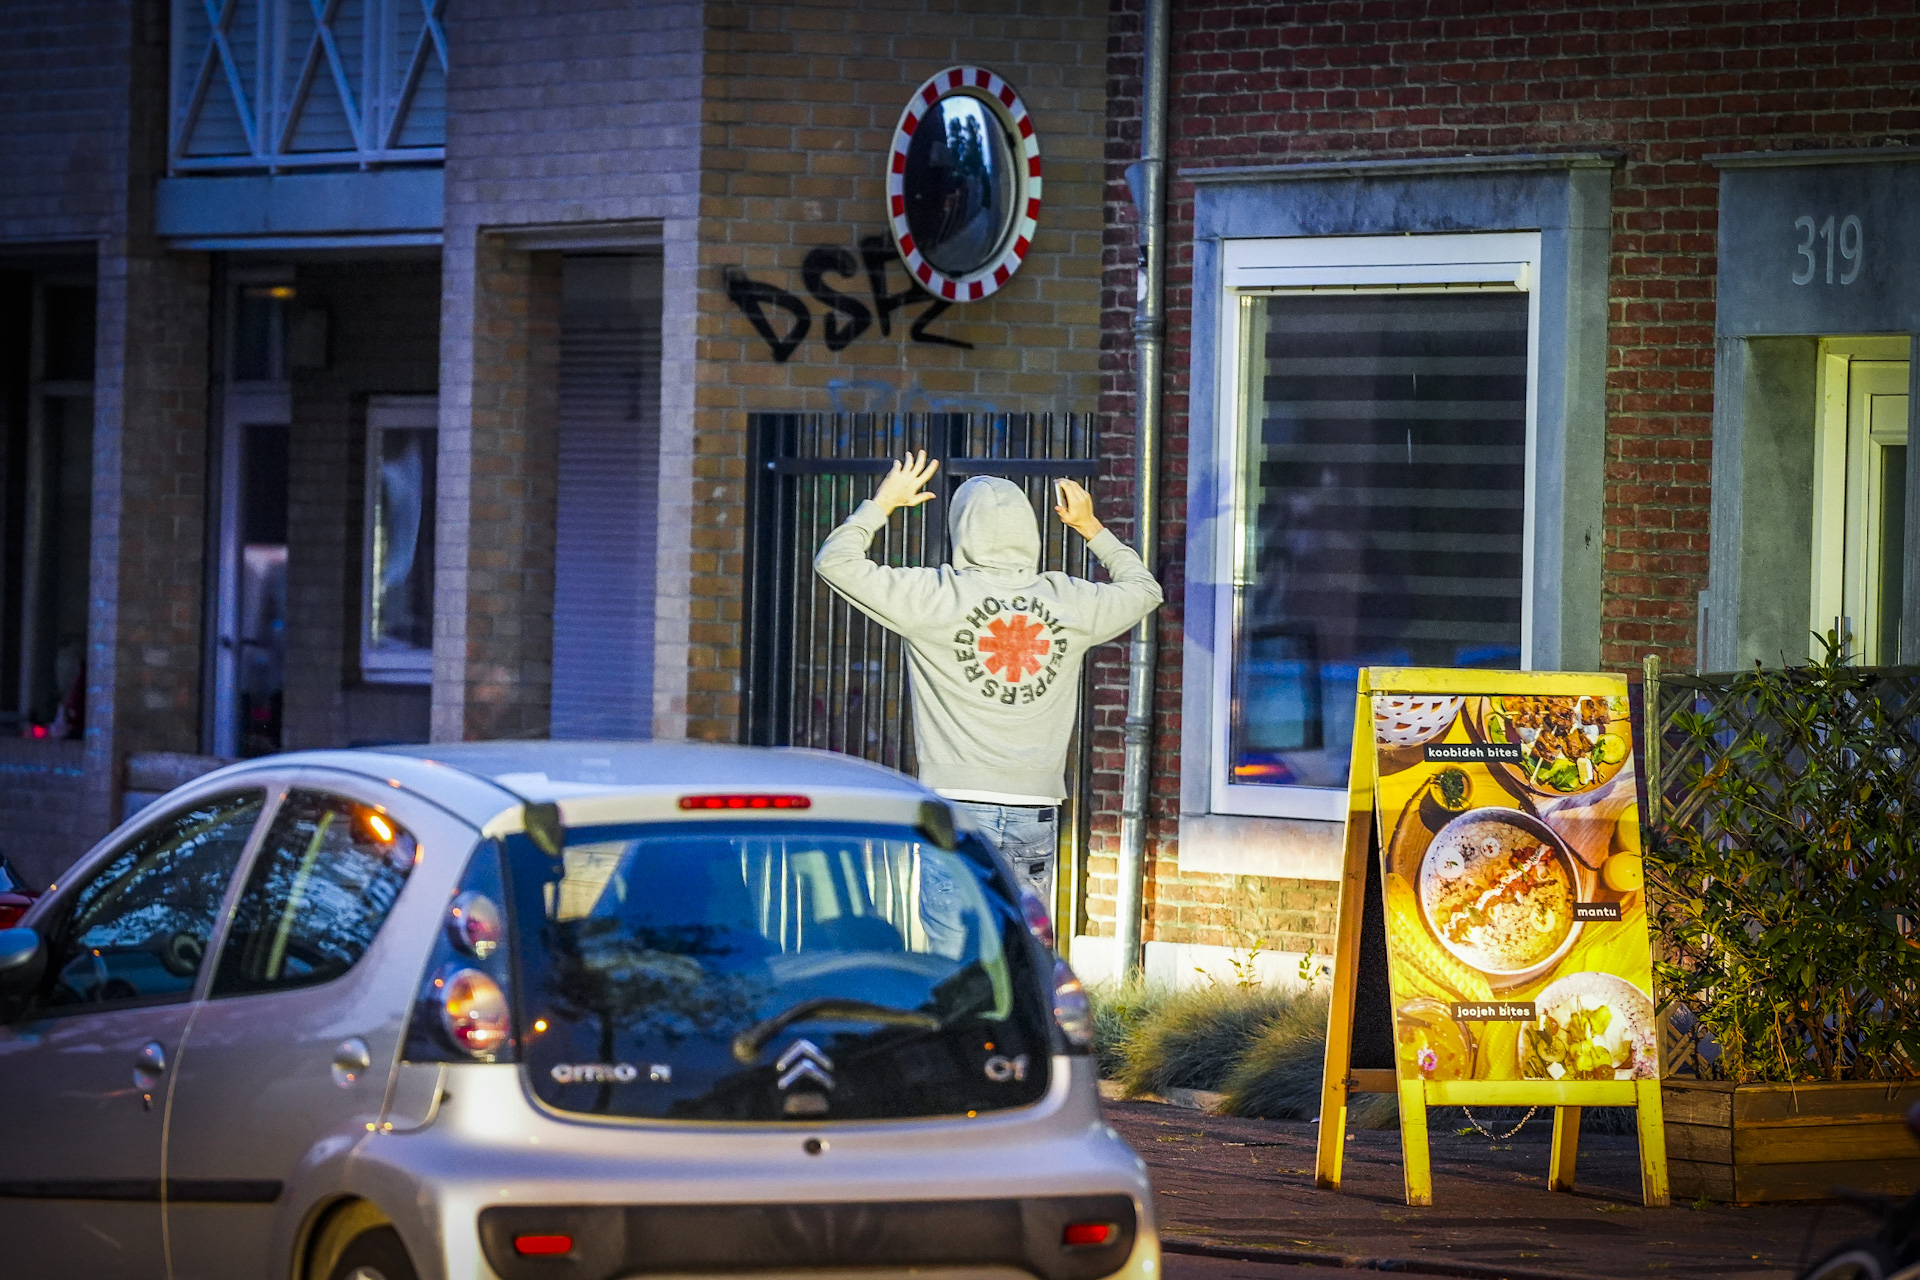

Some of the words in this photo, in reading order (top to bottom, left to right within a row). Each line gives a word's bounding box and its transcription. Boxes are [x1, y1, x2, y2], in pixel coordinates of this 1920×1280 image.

[1792, 214, 1863, 286] 319
[965, 596, 1010, 629] HOT
[953, 628, 986, 683] RED
[981, 637, 1068, 706] PEPPERS
[1428, 747, 1484, 758] koobideh
[1487, 747, 1519, 758] bites
[1577, 906, 1617, 917] mantu
[1457, 1006, 1496, 1018] joojeh
[1499, 1006, 1531, 1017] bites
